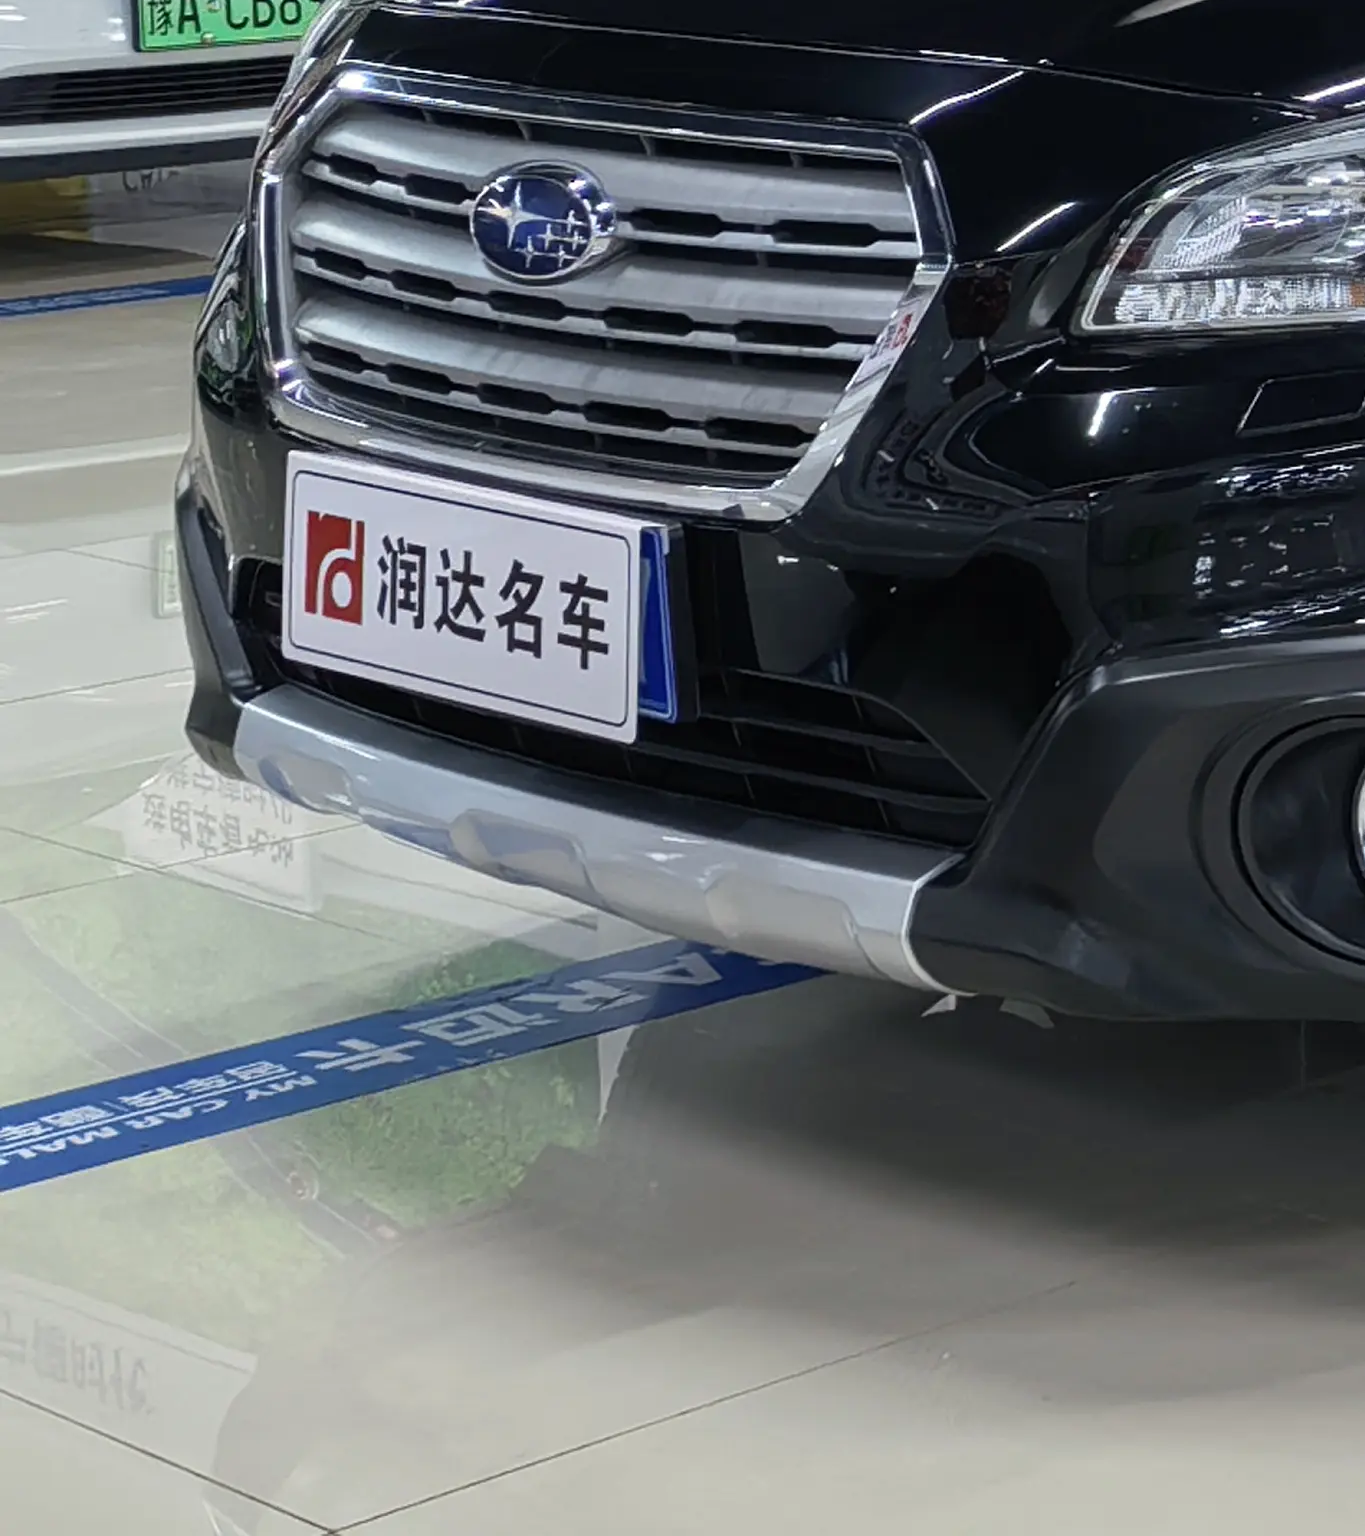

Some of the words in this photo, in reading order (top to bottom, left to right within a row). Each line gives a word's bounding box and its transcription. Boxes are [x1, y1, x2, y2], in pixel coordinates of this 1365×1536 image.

[376, 533, 610, 671] 润达名车
[245, 1074, 317, 1102] MY
[125, 1098, 229, 1131] CAR
